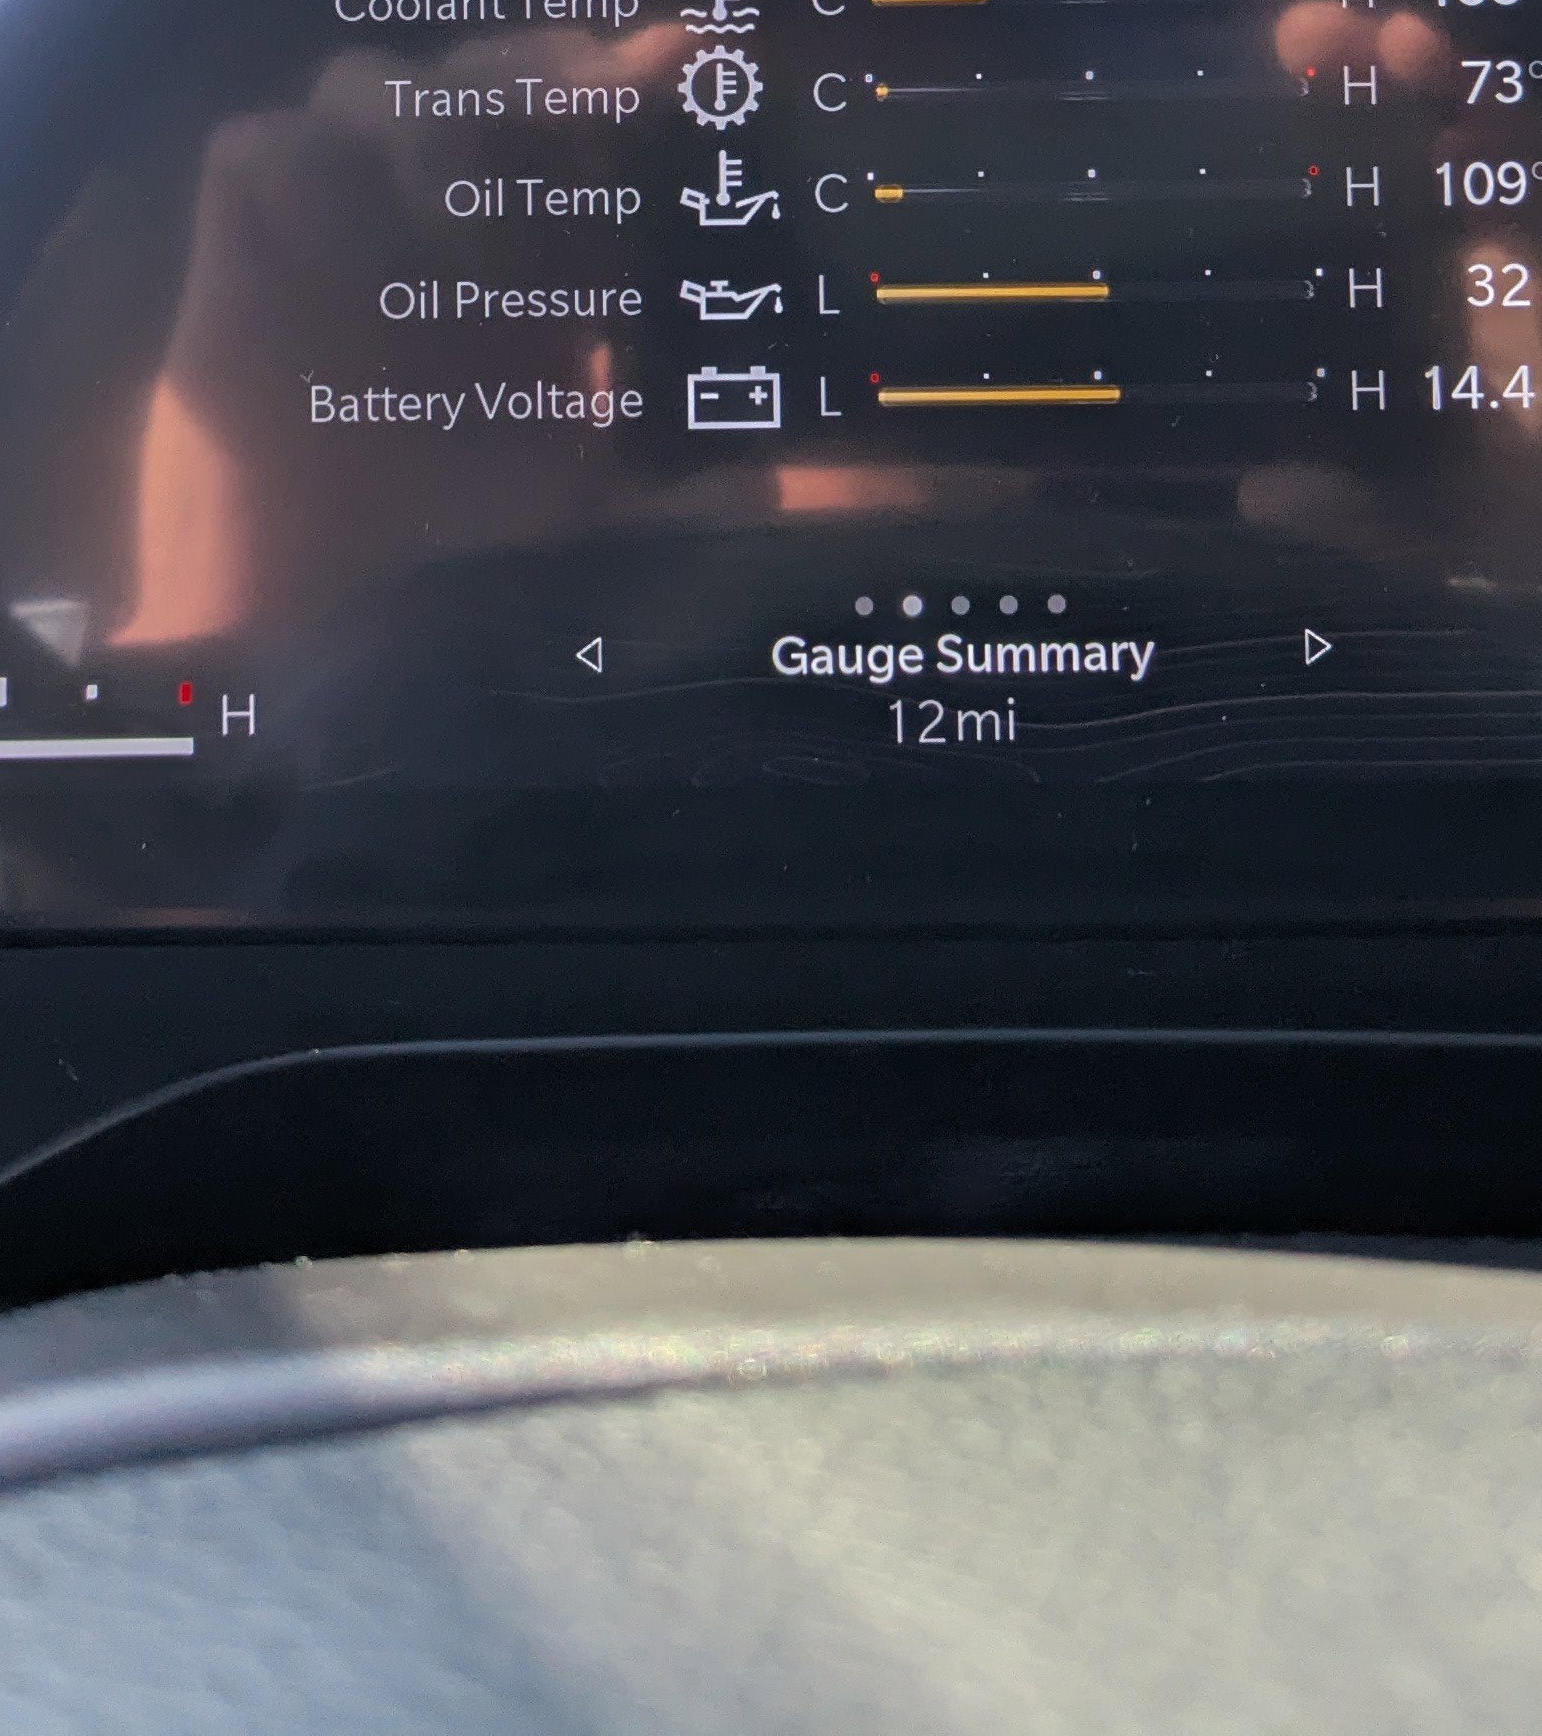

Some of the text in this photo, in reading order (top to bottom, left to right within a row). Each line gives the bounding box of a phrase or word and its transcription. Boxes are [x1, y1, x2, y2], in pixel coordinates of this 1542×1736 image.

[385, 77, 640, 123] Trans Temp
[813, 72, 848, 113] C
[1343, 65, 1378, 106] H
[445, 178, 641, 224] Oil Temp
[814, 173, 849, 213] C
[1345, 166, 1380, 207] H
[379, 280, 642, 321] Oil Pressure
[818, 275, 841, 316] L
[1348, 267, 1383, 309] H
[1466, 263, 1532, 307] 32
[310, 381, 644, 431] Battery Voltage
[820, 376, 842, 417] L
[1351, 368, 1386, 411] H
[1424, 364, 1535, 411] 14.4
[771, 633, 1156, 685] Gauge Summary
[221, 694, 257, 736] H
